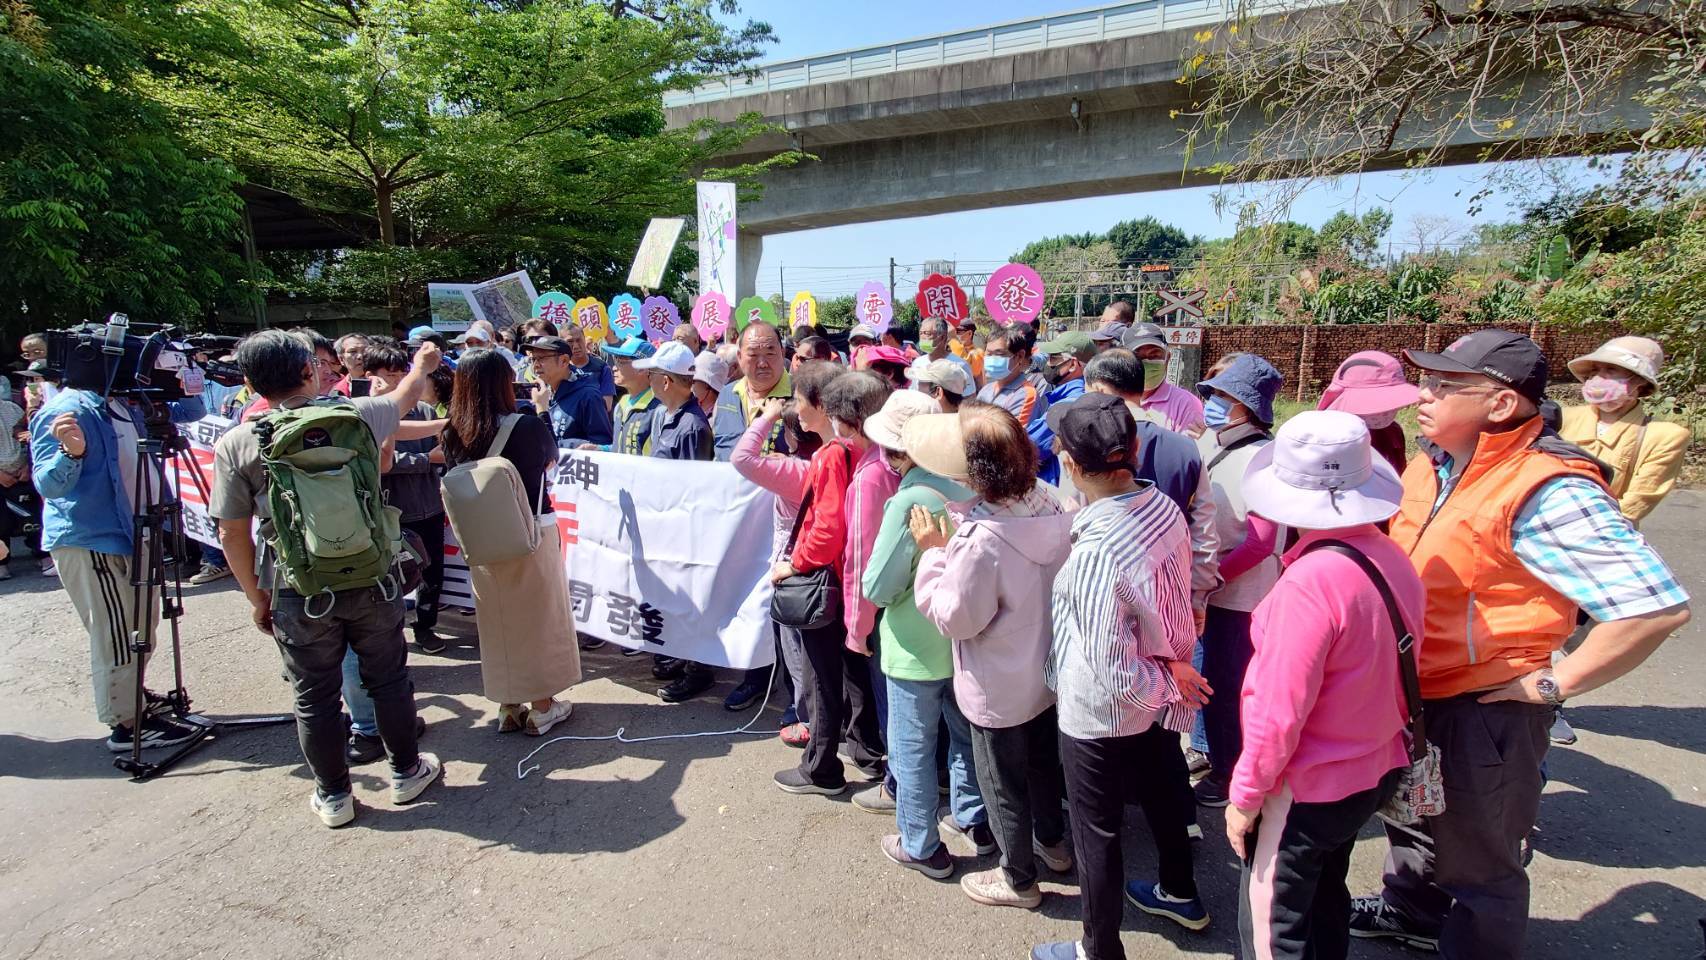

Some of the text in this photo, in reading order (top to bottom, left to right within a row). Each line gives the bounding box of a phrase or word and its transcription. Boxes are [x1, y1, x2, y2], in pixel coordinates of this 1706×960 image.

[863, 293, 885, 325] 需
[925, 286, 959, 319] 開
[996, 276, 1039, 313] 發
[579, 305, 602, 329] 頭
[614, 303, 637, 328] 要
[649, 306, 674, 335] 發
[699, 300, 724, 328] 展
[1483, 366, 1513, 383] NISSAN
[558, 454, 599, 490] 紳
